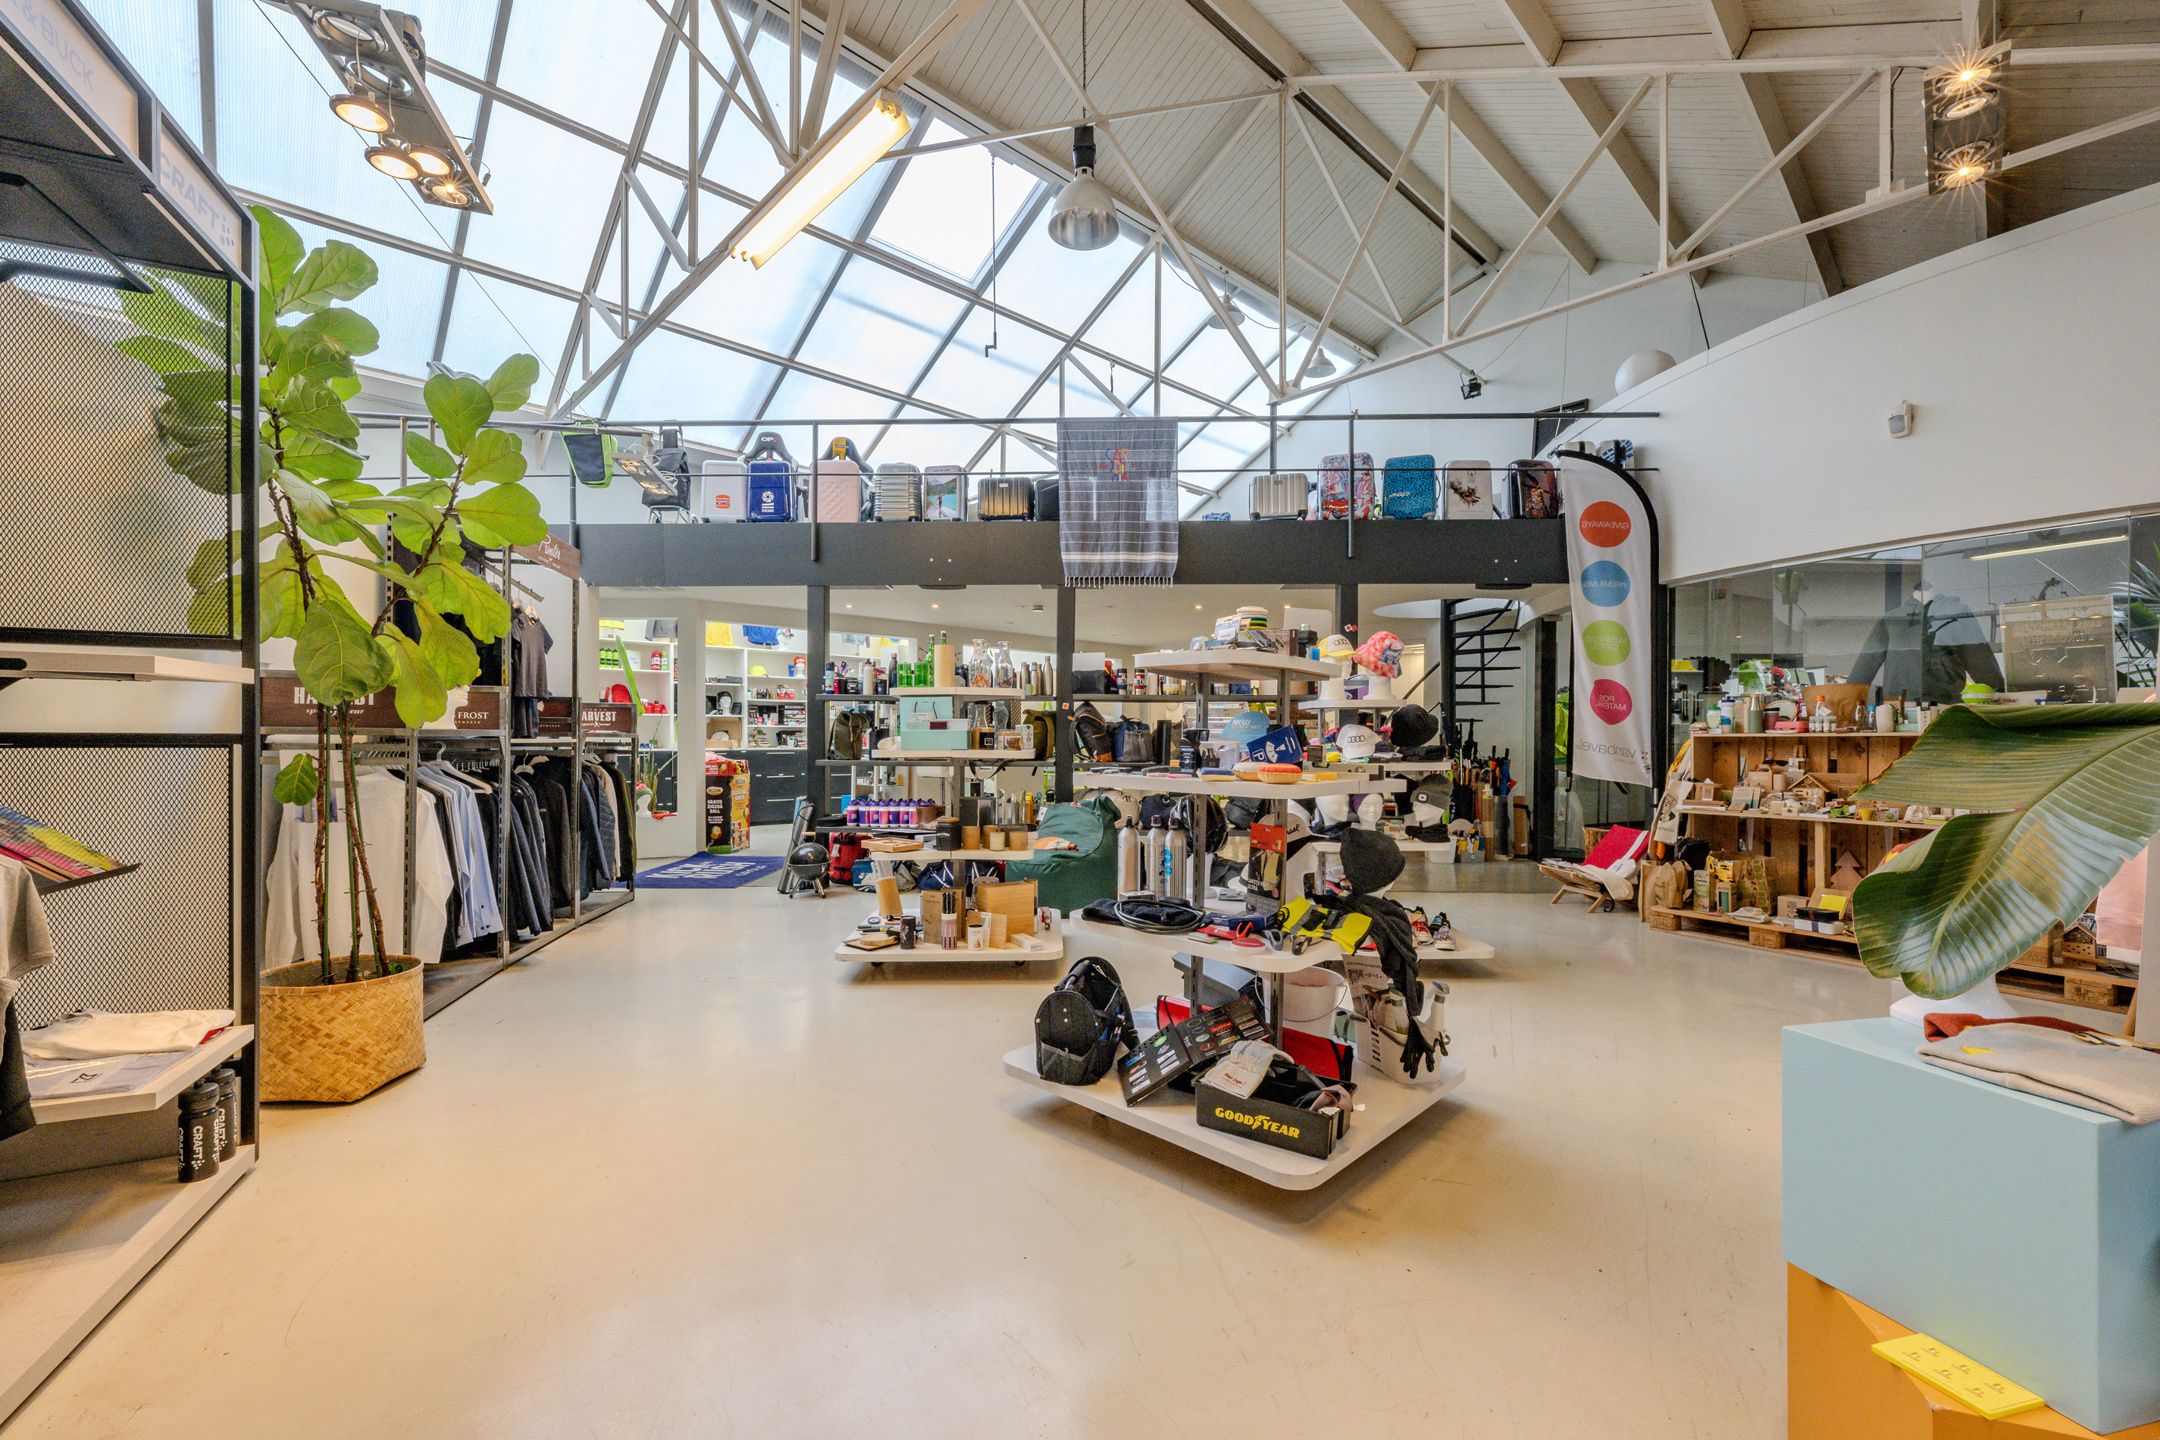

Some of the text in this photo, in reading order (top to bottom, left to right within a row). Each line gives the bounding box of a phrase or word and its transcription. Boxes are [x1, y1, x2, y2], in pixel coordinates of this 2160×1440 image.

[40, 14, 95, 95] BUCK
[160, 151, 219, 230] CRAFT
[457, 711, 489, 720] FROST
[581, 711, 617, 721] ARVEST
[1214, 1106, 1300, 1139] GOODYEAR
[192, 1125, 204, 1161] CRAFT
